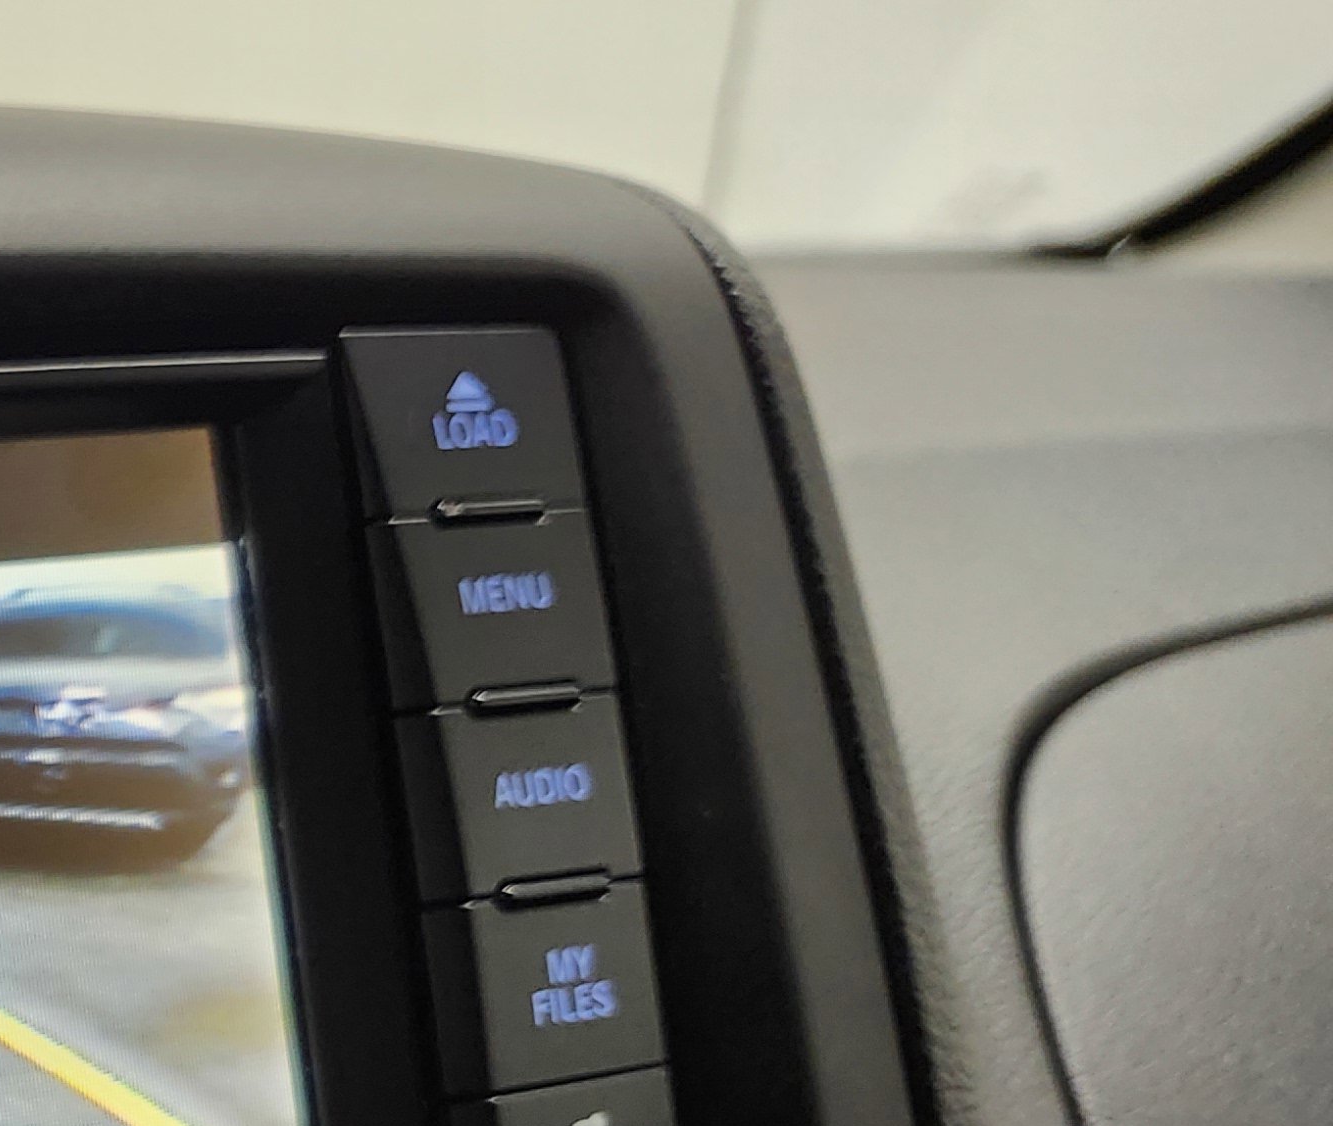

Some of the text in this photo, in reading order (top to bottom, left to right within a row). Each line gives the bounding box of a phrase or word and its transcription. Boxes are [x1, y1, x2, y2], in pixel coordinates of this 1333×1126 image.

[433, 409, 520, 450] LOAD
[458, 572, 555, 615] MENU
[494, 762, 591, 809] AUDIO
[546, 945, 595, 984] MY
[531, 980, 617, 1026] FILES
